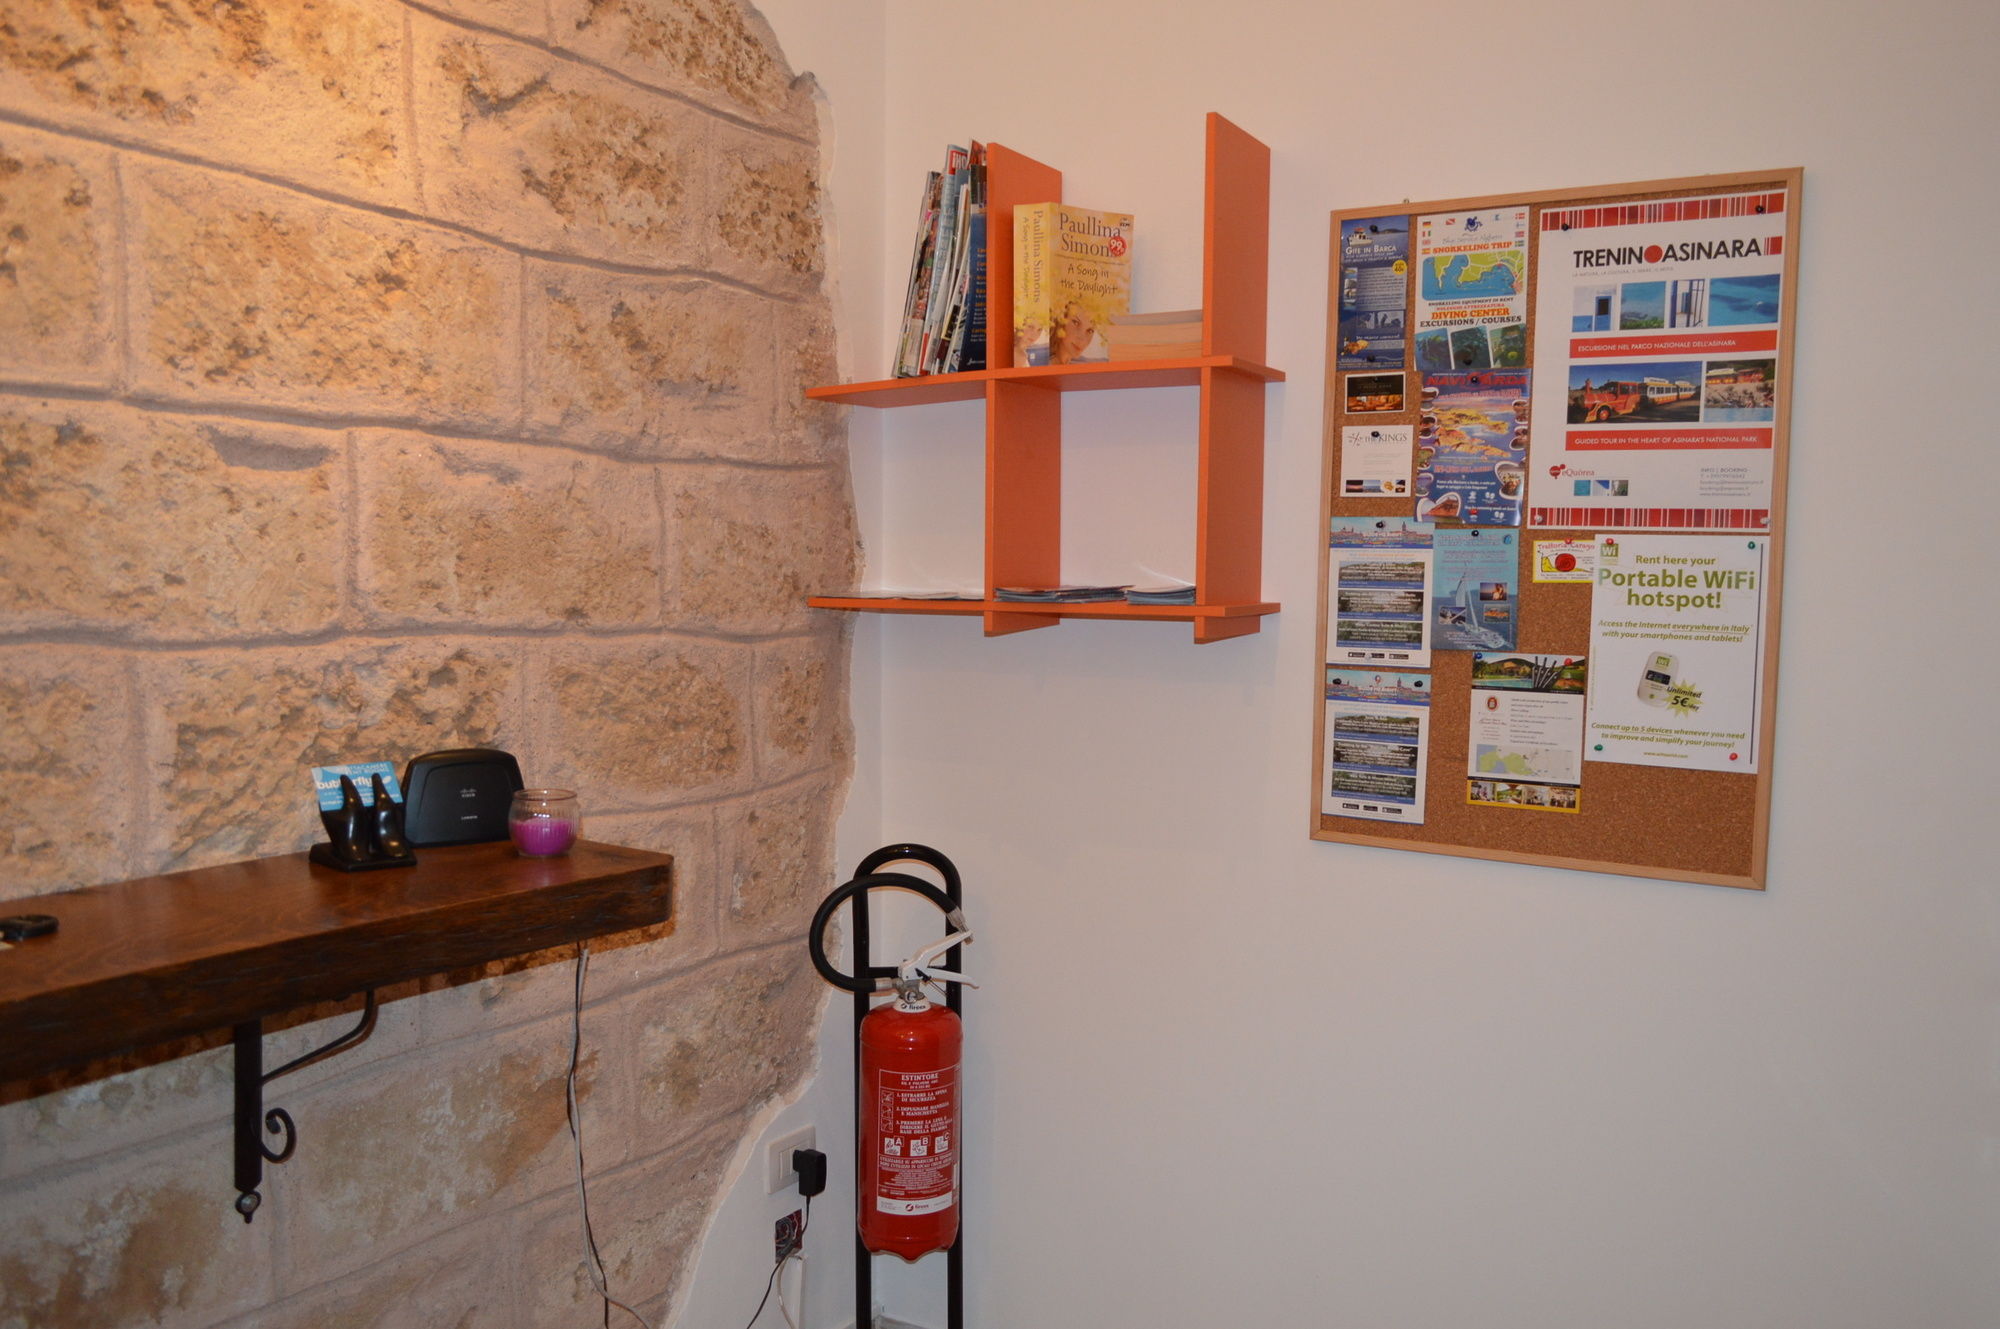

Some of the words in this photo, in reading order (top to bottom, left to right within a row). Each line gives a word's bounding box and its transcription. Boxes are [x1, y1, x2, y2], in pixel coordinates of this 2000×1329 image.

[1060, 212, 1120, 237] Paullina
[1034, 210, 1044, 258] Paullina
[1061, 232, 1114, 257] Simon
[1433, 243, 1489, 254] SNORKELING
[1662, 238, 1762, 262] ASINARA
[1068, 264, 1074, 274] A
[1076, 265, 1098, 280] Song
[1102, 269, 1109, 278] in
[1034, 260, 1042, 302] Simons
[1060, 280, 1074, 289] the
[1078, 280, 1118, 297] Daylight
[1432, 310, 1467, 320] DIVING
[1470, 308, 1510, 317] CENTER
[1420, 318, 1474, 327] EXCURSIONS
[1482, 316, 1522, 324] COURSES
[1578, 344, 1616, 352] ESCURSIONE
[1654, 341, 1691, 349] NAZIONALE
[1692, 339, 1736, 348] DELL'ASINARA
[1602, 546, 1616, 556] Wi
[1636, 555, 1662, 564] Rent
[1663, 555, 1688, 565] here
[1690, 558, 1716, 566] your
[1598, 568, 1697, 588] Portable
[1703, 570, 1754, 590] WiFi
[1627, 588, 1721, 612] hotspot!
[1672, 624, 1720, 632] everywhere
[1640, 632, 1692, 642] smartphones
[1666, 686, 1702, 698] Unlimited
[1656, 736, 1683, 745] simplify
[1703, 740, 1735, 748] journey!
